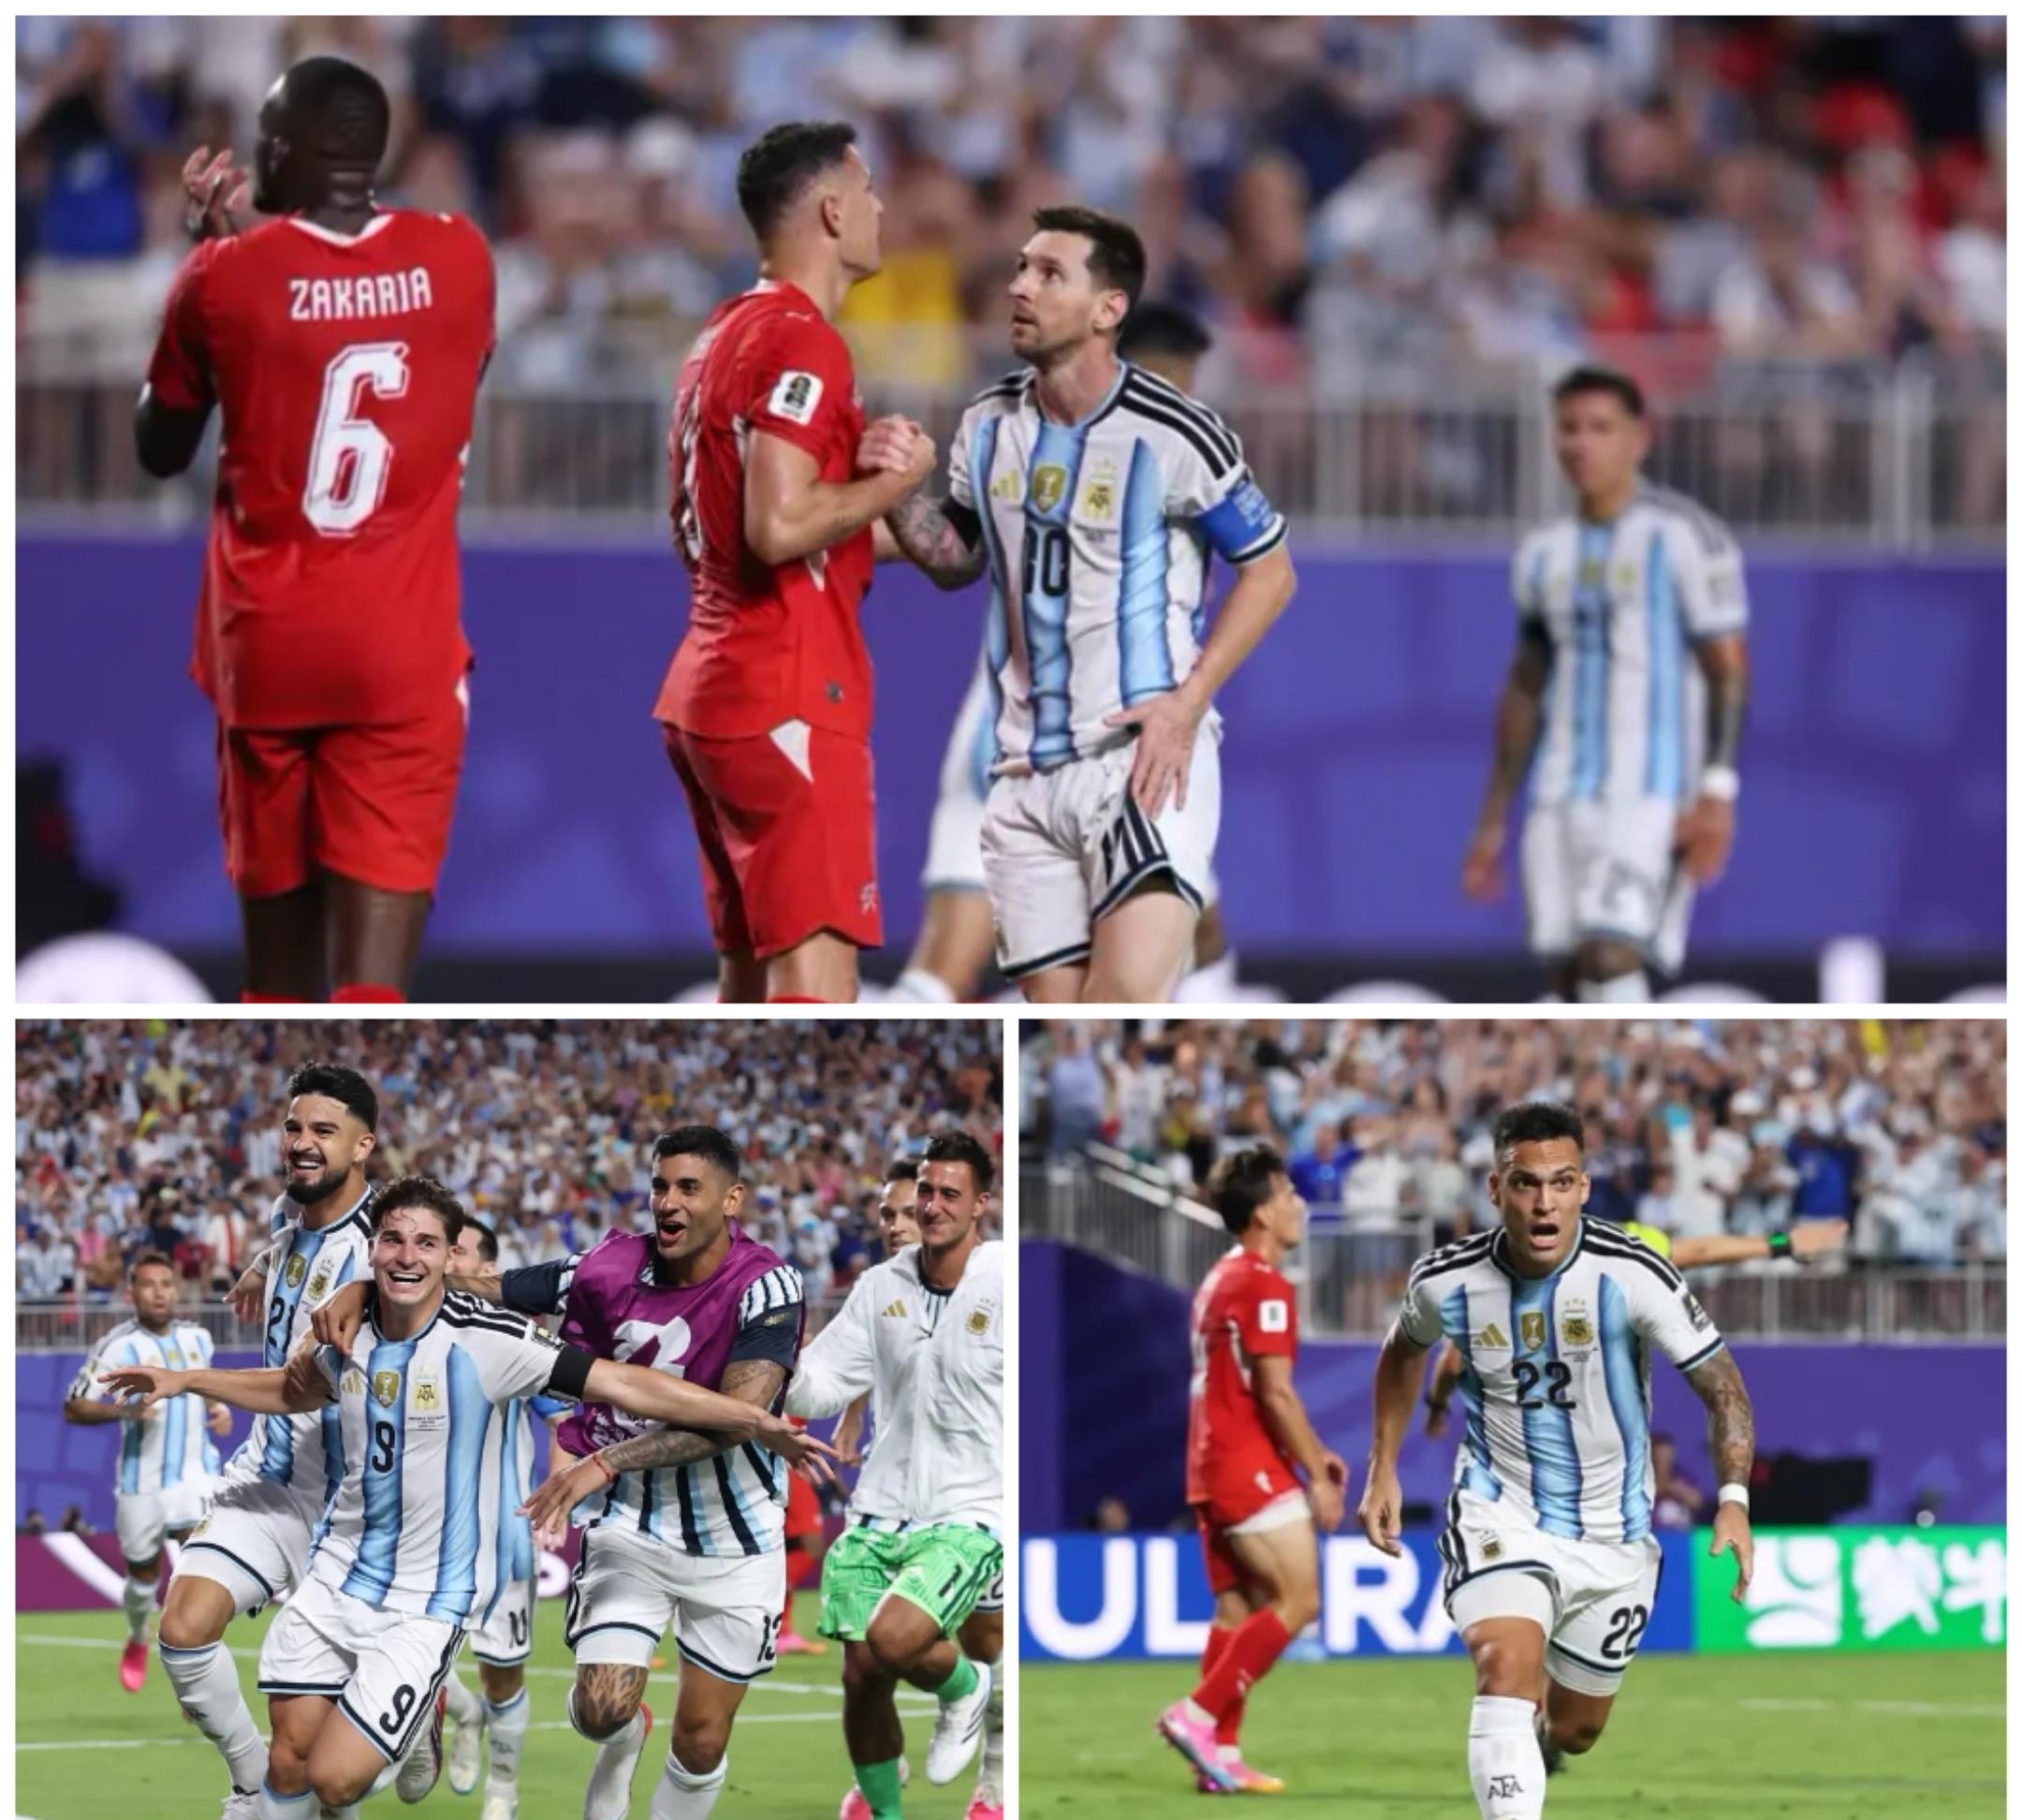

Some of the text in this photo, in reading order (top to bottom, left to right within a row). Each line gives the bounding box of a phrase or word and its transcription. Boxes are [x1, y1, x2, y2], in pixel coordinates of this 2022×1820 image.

[289, 266, 432, 321] ZAKARIA
[301, 341, 411, 538] 6
[1511, 1360, 1577, 1410] 22
[372, 1420, 396, 1474] 9
[939, 1563, 962, 1598] 1
[1023, 1536, 1458, 1659] ULR
[1601, 1604, 1648, 1660] 22
[379, 1683, 417, 1736] 9
